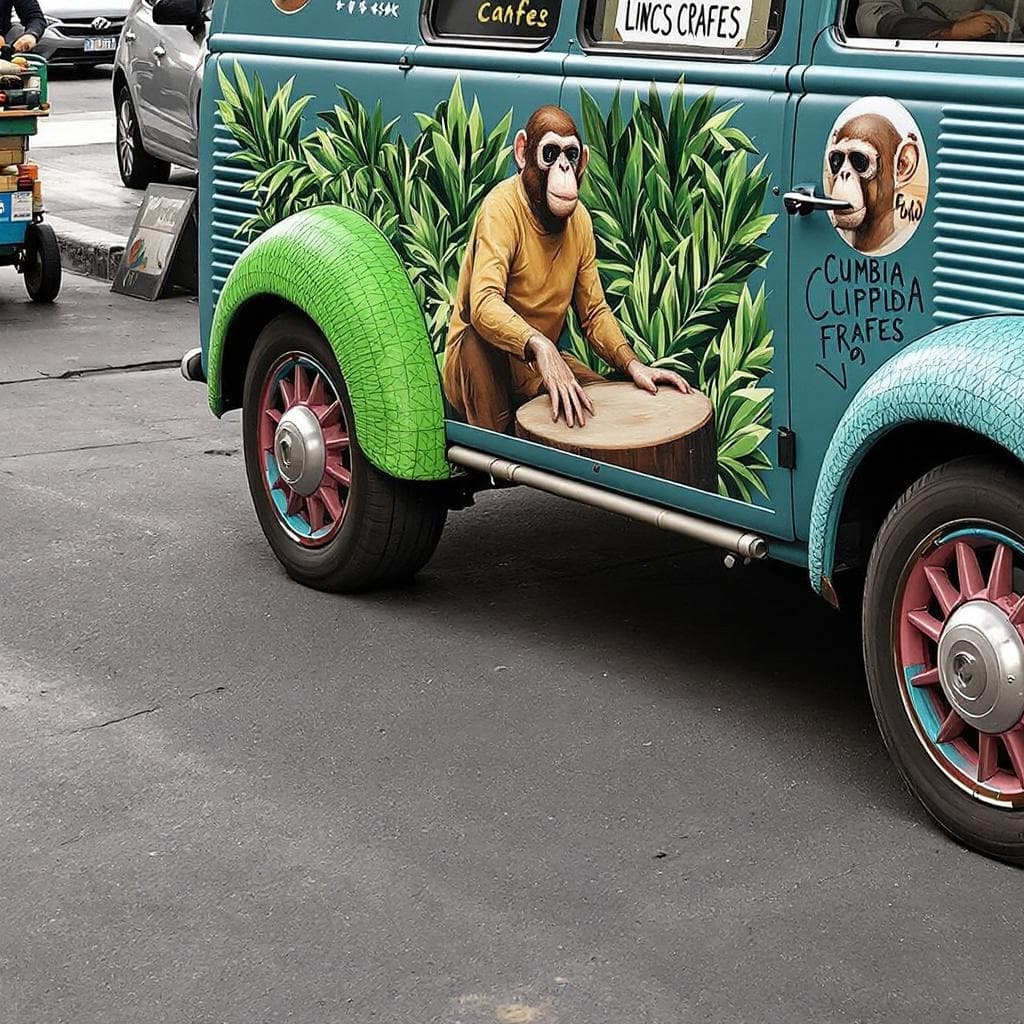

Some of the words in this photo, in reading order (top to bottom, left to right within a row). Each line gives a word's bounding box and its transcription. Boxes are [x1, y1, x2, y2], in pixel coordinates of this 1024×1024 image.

[625, 0, 672, 36] LINCS
[824, 253, 905, 288] CUMBIA
[820, 317, 904, 359] FRAFES
